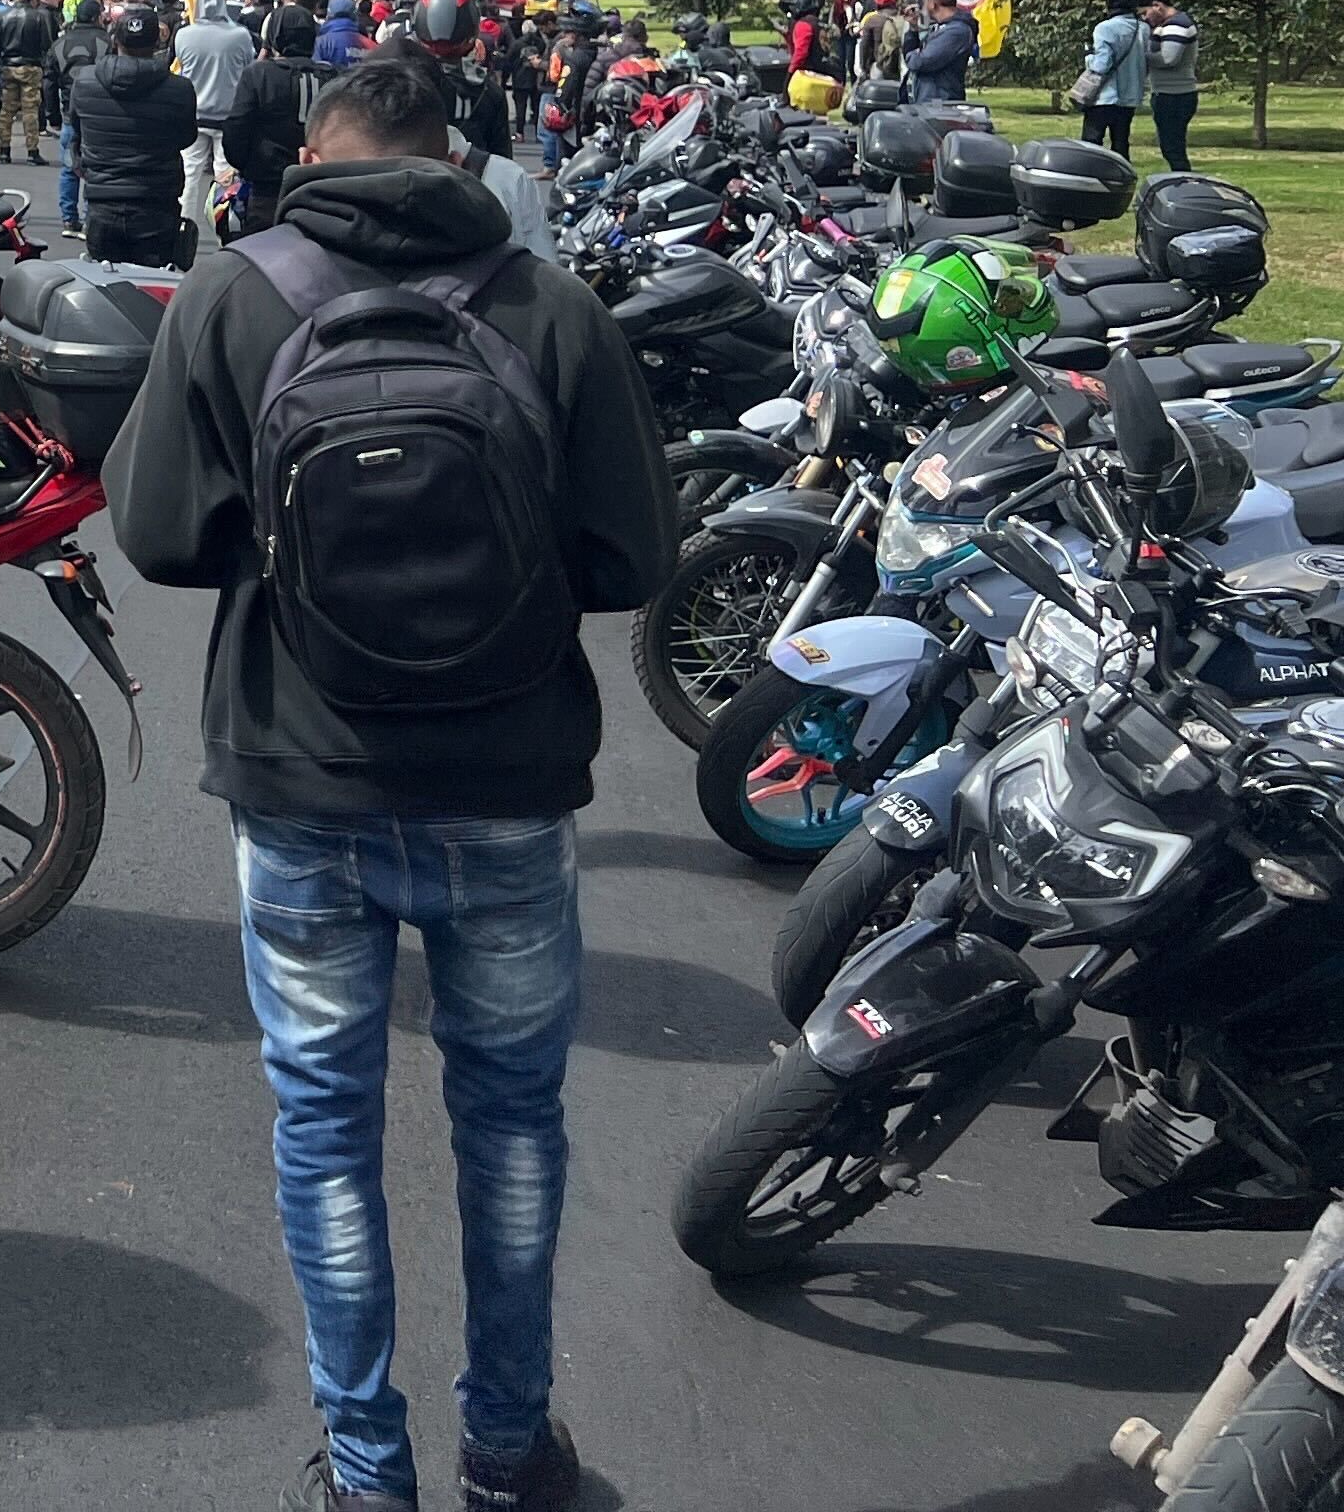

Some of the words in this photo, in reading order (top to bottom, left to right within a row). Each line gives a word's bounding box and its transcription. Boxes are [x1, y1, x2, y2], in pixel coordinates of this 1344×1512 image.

[1243, 365, 1281, 377] auteco
[878, 797, 926, 839] TAURI
[887, 791, 933, 831] ALPHA
[853, 998, 893, 1035] TVS
